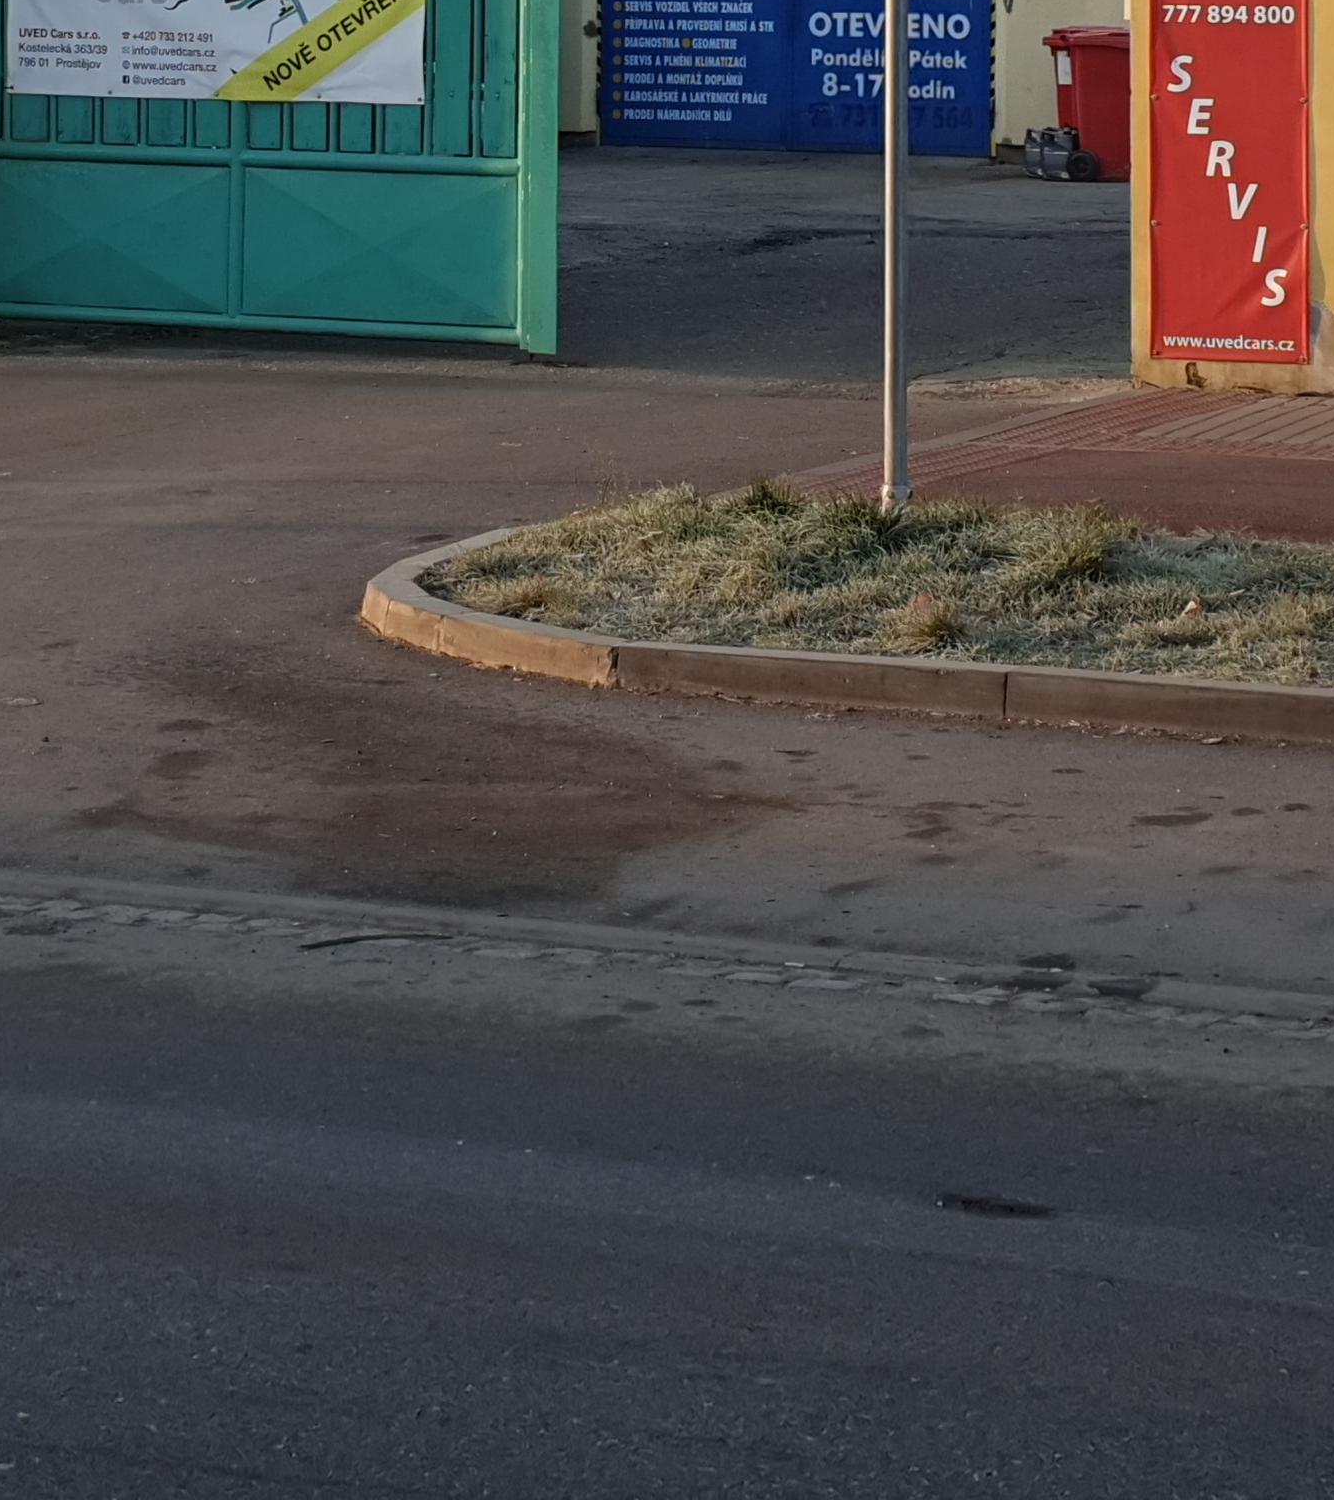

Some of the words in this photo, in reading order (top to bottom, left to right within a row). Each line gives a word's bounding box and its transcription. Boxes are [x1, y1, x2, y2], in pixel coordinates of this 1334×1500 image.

[625, 1, 653, 13] SERVIS
[655, 1, 690, 13] VOZIDEL
[693, 0, 719, 13] VŠECH
[720, 0, 754, 14] ZNAČEK
[1162, 4, 1204, 25] 777
[1207, 4, 1248, 25] 894
[1252, 5, 1295, 26] 800
[759, 20, 775, 33] STK
[808, 12, 971, 40] OTEVENO
[19, 28, 48, 39] UVED
[50, 29, 74, 40] Cars
[76, 31, 101, 40] s.r.o.
[132, 32, 157, 41] +420
[177, 33, 194, 42] 212
[197, 33, 214, 43] 491
[19, 43, 72, 54] Kostelecká
[74, 45, 108, 55] 363/39
[624, 37, 681, 49] DIAGNOSTIKA
[692, 38, 738, 50] GEOMETRIE
[131, 46, 216, 57] info@uvedcars.cz
[19, 57, 36, 67] 796
[38, 58, 49, 68] 01
[56, 59, 101, 70] Prostějov
[624, 55, 653, 66] SERVIS
[694, 55, 747, 68] KLIMATIZACÍ
[909, 50, 967, 69] Pátek
[132, 62, 217, 72] www.uvedcars.cz
[262, 42, 317, 92] NOVĚ
[132, 76, 186, 86] @uvedcars
[624, 73, 655, 85] PRODEJ
[822, 72, 884, 98] 8-17
[907, 80, 956, 99] odin
[624, 108, 655, 120] PRODEJ
[1166, 53, 1288, 308] SERVIS
[1163, 333, 1296, 353] www.uvedcars.cz
